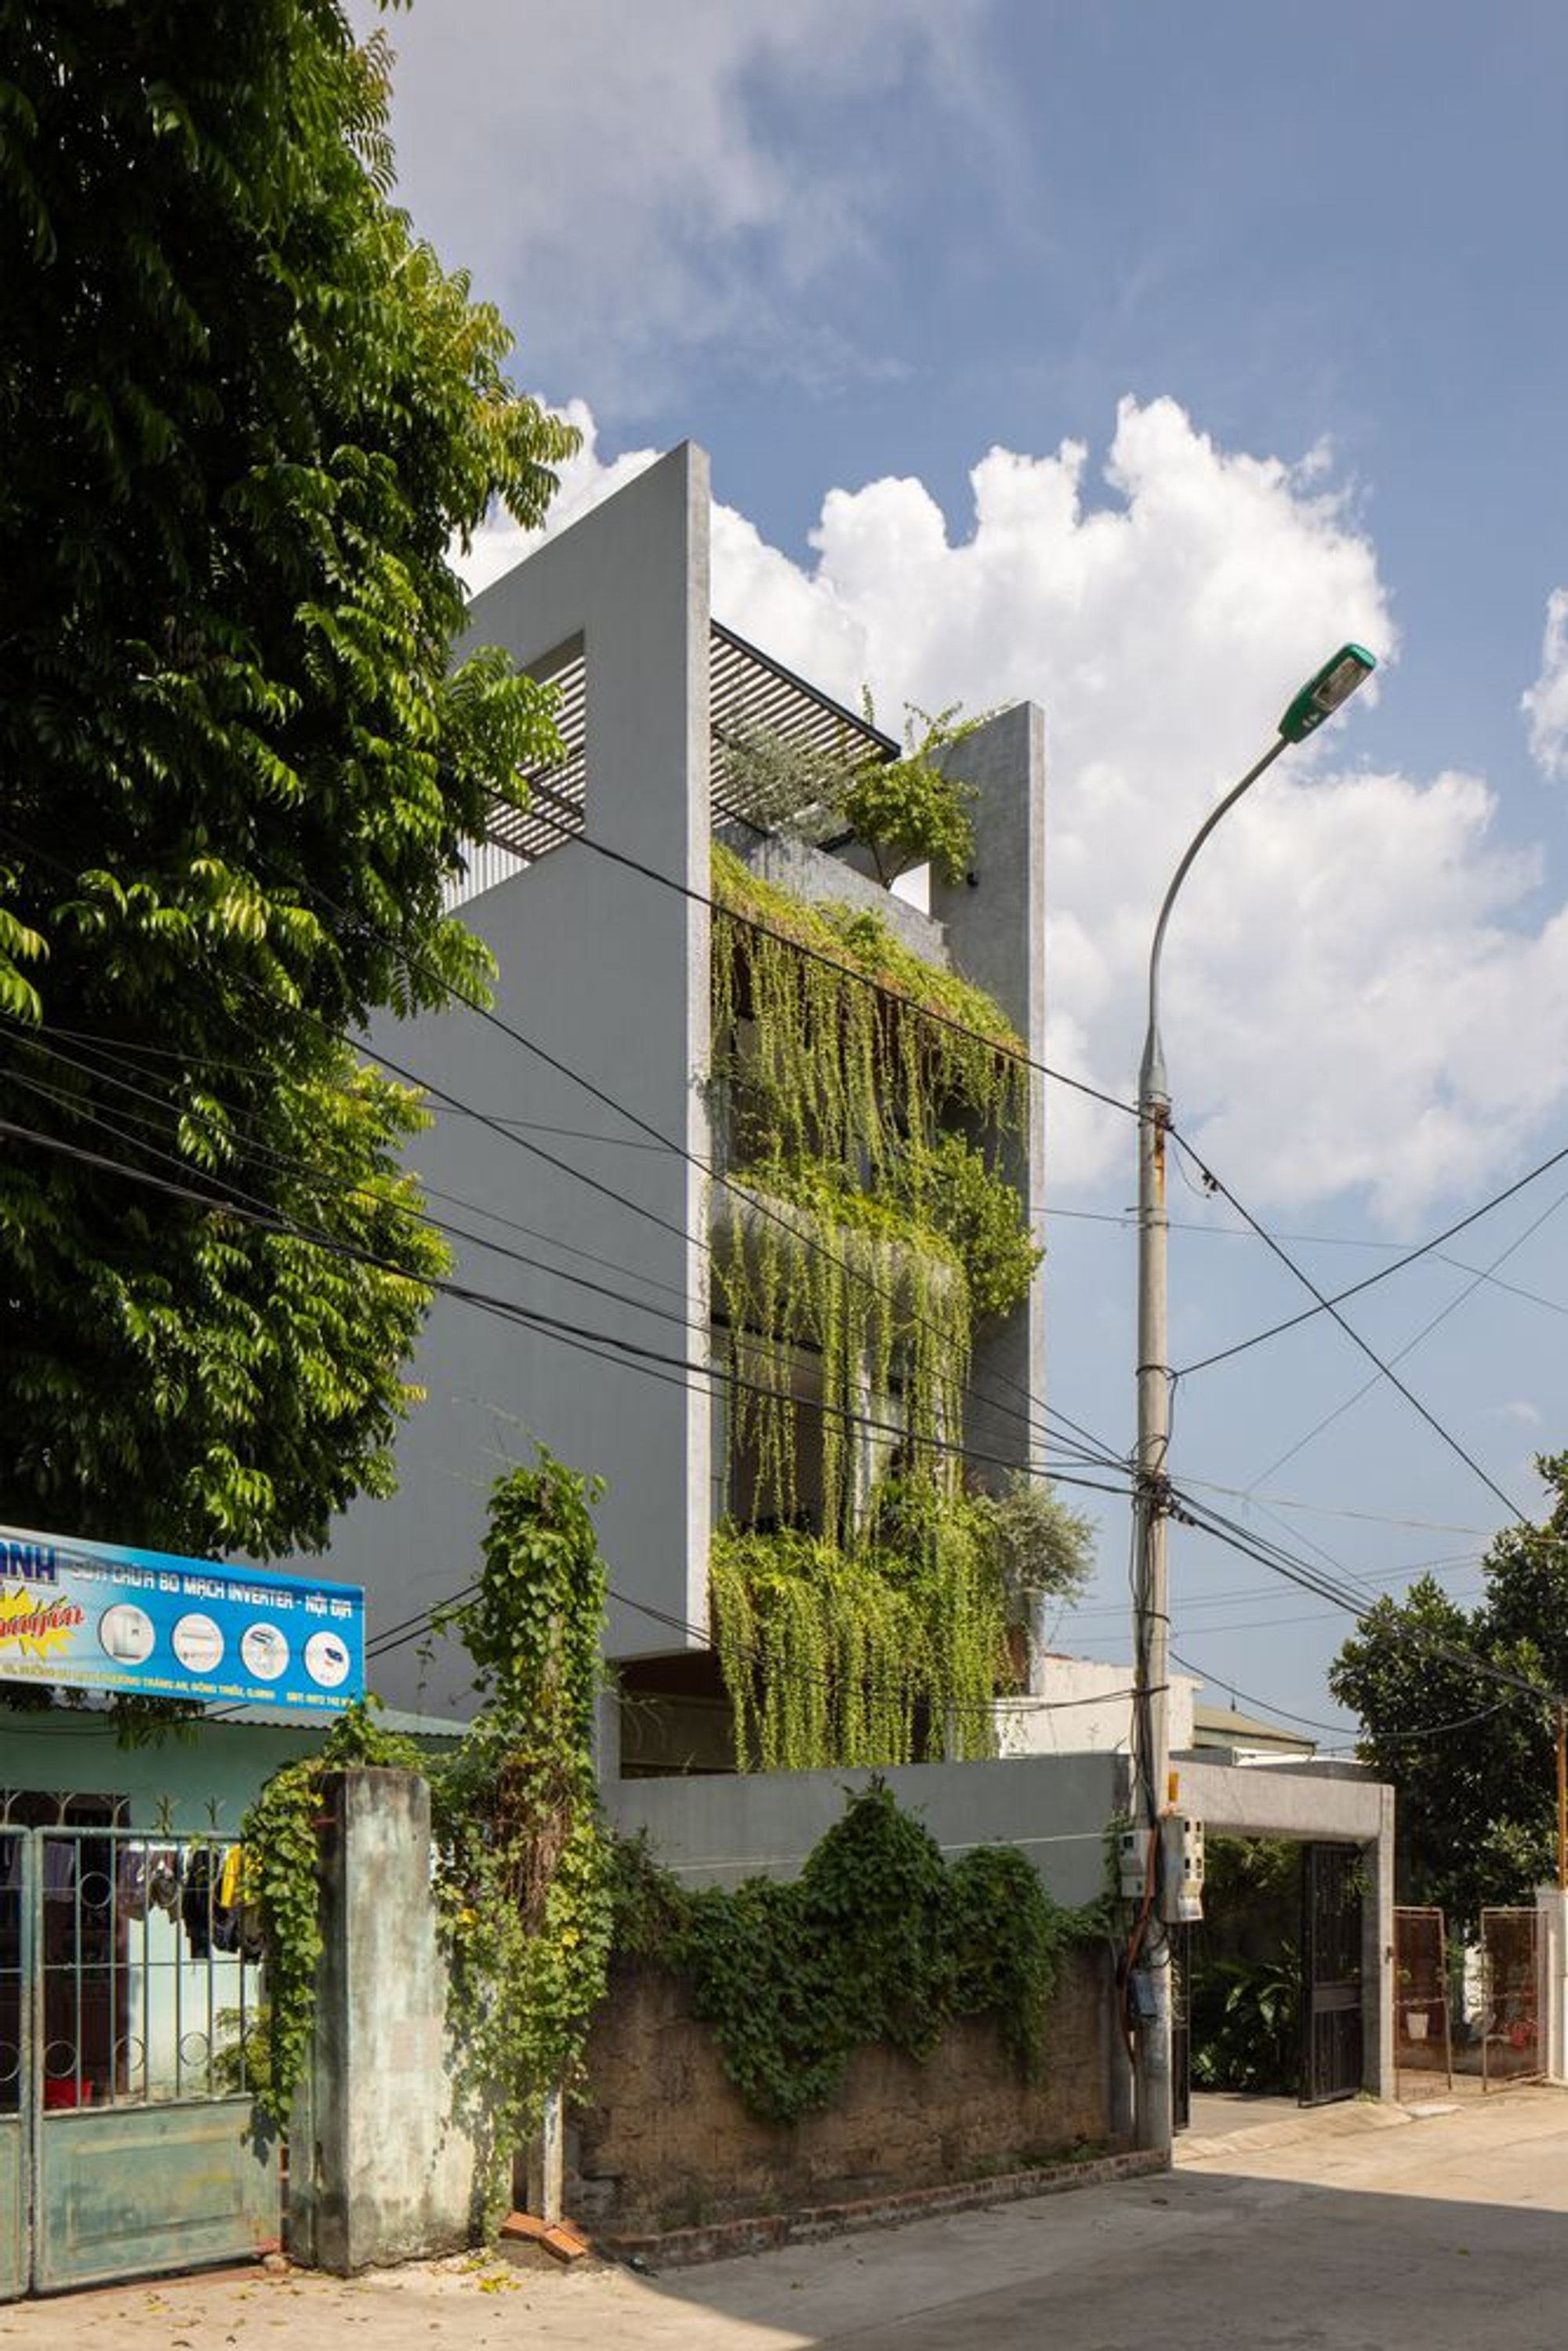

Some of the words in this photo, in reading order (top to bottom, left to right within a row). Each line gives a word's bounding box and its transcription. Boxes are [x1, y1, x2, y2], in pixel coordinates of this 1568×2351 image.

[159, 1572, 180, 1593] BO
[183, 1575, 224, 1600] MẠCH
[228, 1582, 293, 1609] INVERTER
